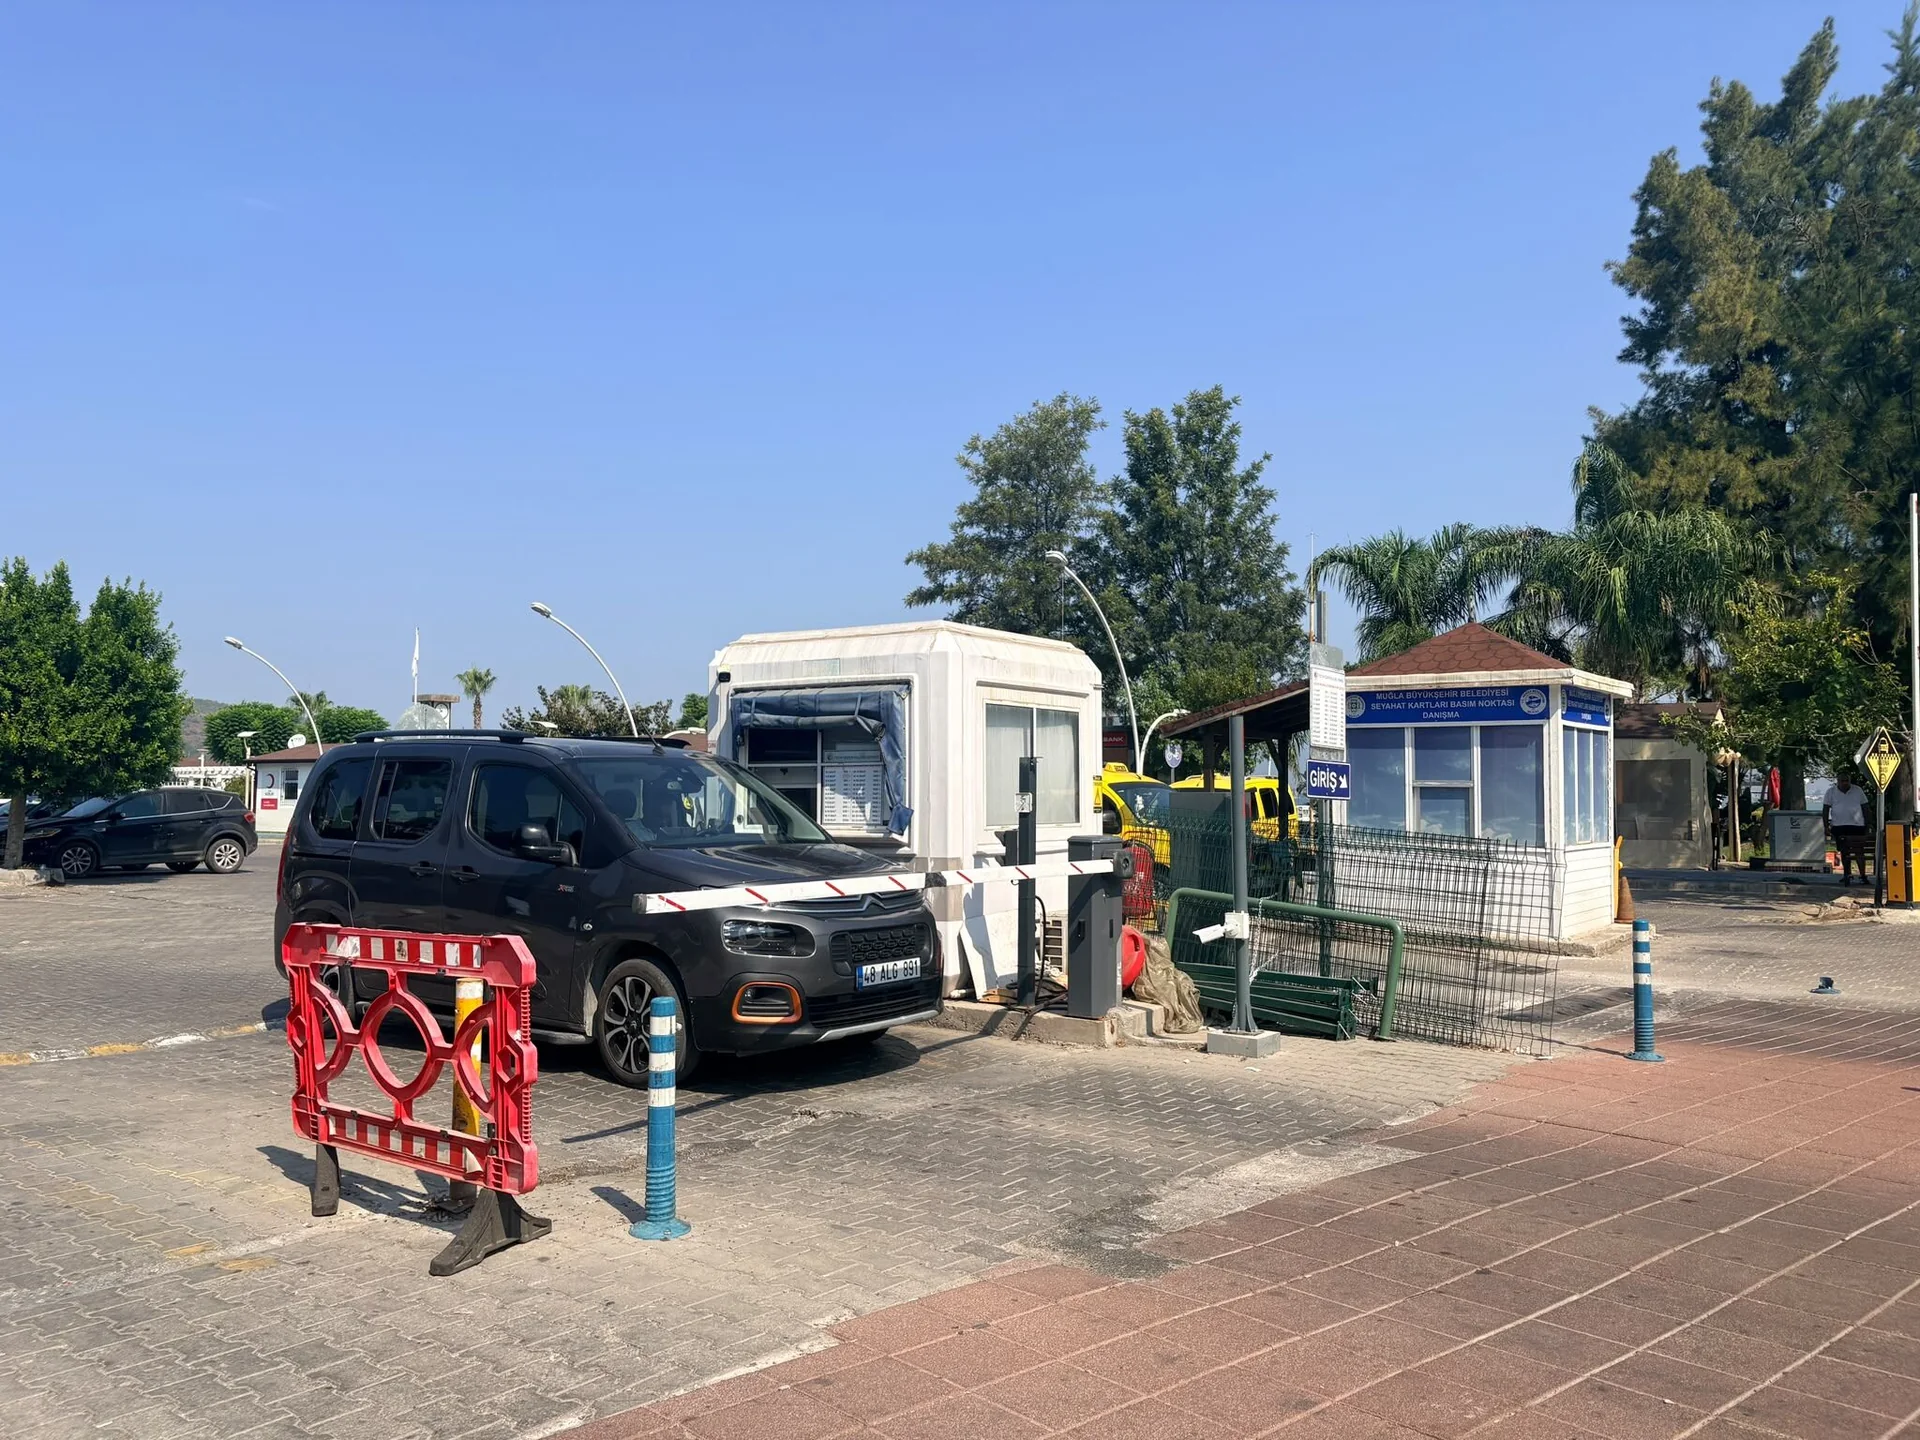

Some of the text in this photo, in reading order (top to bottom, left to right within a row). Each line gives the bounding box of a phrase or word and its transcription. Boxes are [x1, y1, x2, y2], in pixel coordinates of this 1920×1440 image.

[1376, 688, 1509, 700] MUĞLA BÜYÜKŞEHİR BELEDİYESİ
[1371, 699, 1515, 710] SEYAHAT KARTLARI BASIM NOKTASI
[1422, 711, 1460, 719] DANIŞMA
[1309, 767, 1337, 792] GİRİŞ
[864, 960, 919, 984] 48 ALG 891
